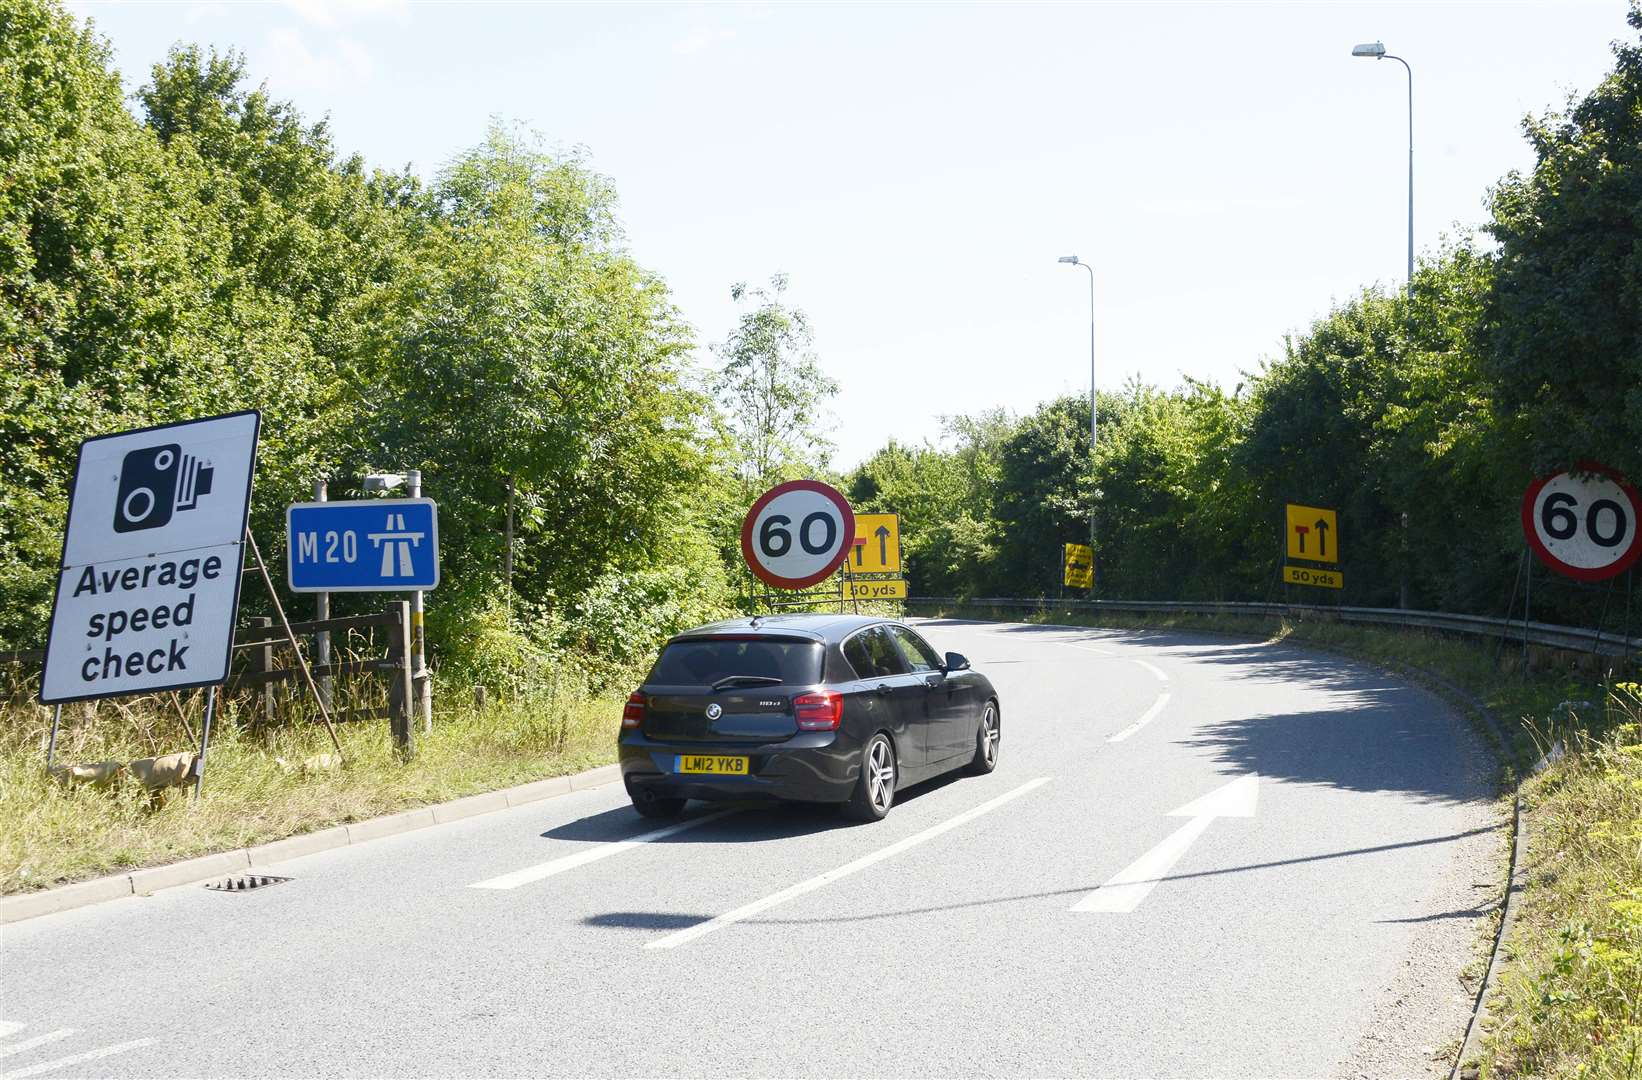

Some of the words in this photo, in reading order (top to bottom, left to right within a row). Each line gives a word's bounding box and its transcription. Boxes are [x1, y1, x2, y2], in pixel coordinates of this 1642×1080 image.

[759, 511, 837, 558] 60
[1542, 492, 1627, 547] 60
[72, 555, 222, 598] Average
[850, 585, 869, 595] 50
[873, 585, 896, 596] yds
[1292, 570, 1310, 581] 50
[1312, 573, 1335, 585] yds
[86, 593, 196, 642] speed
[81, 639, 190, 682] check
[685, 757, 713, 771] LM12
[718, 758, 743, 772] YKB
